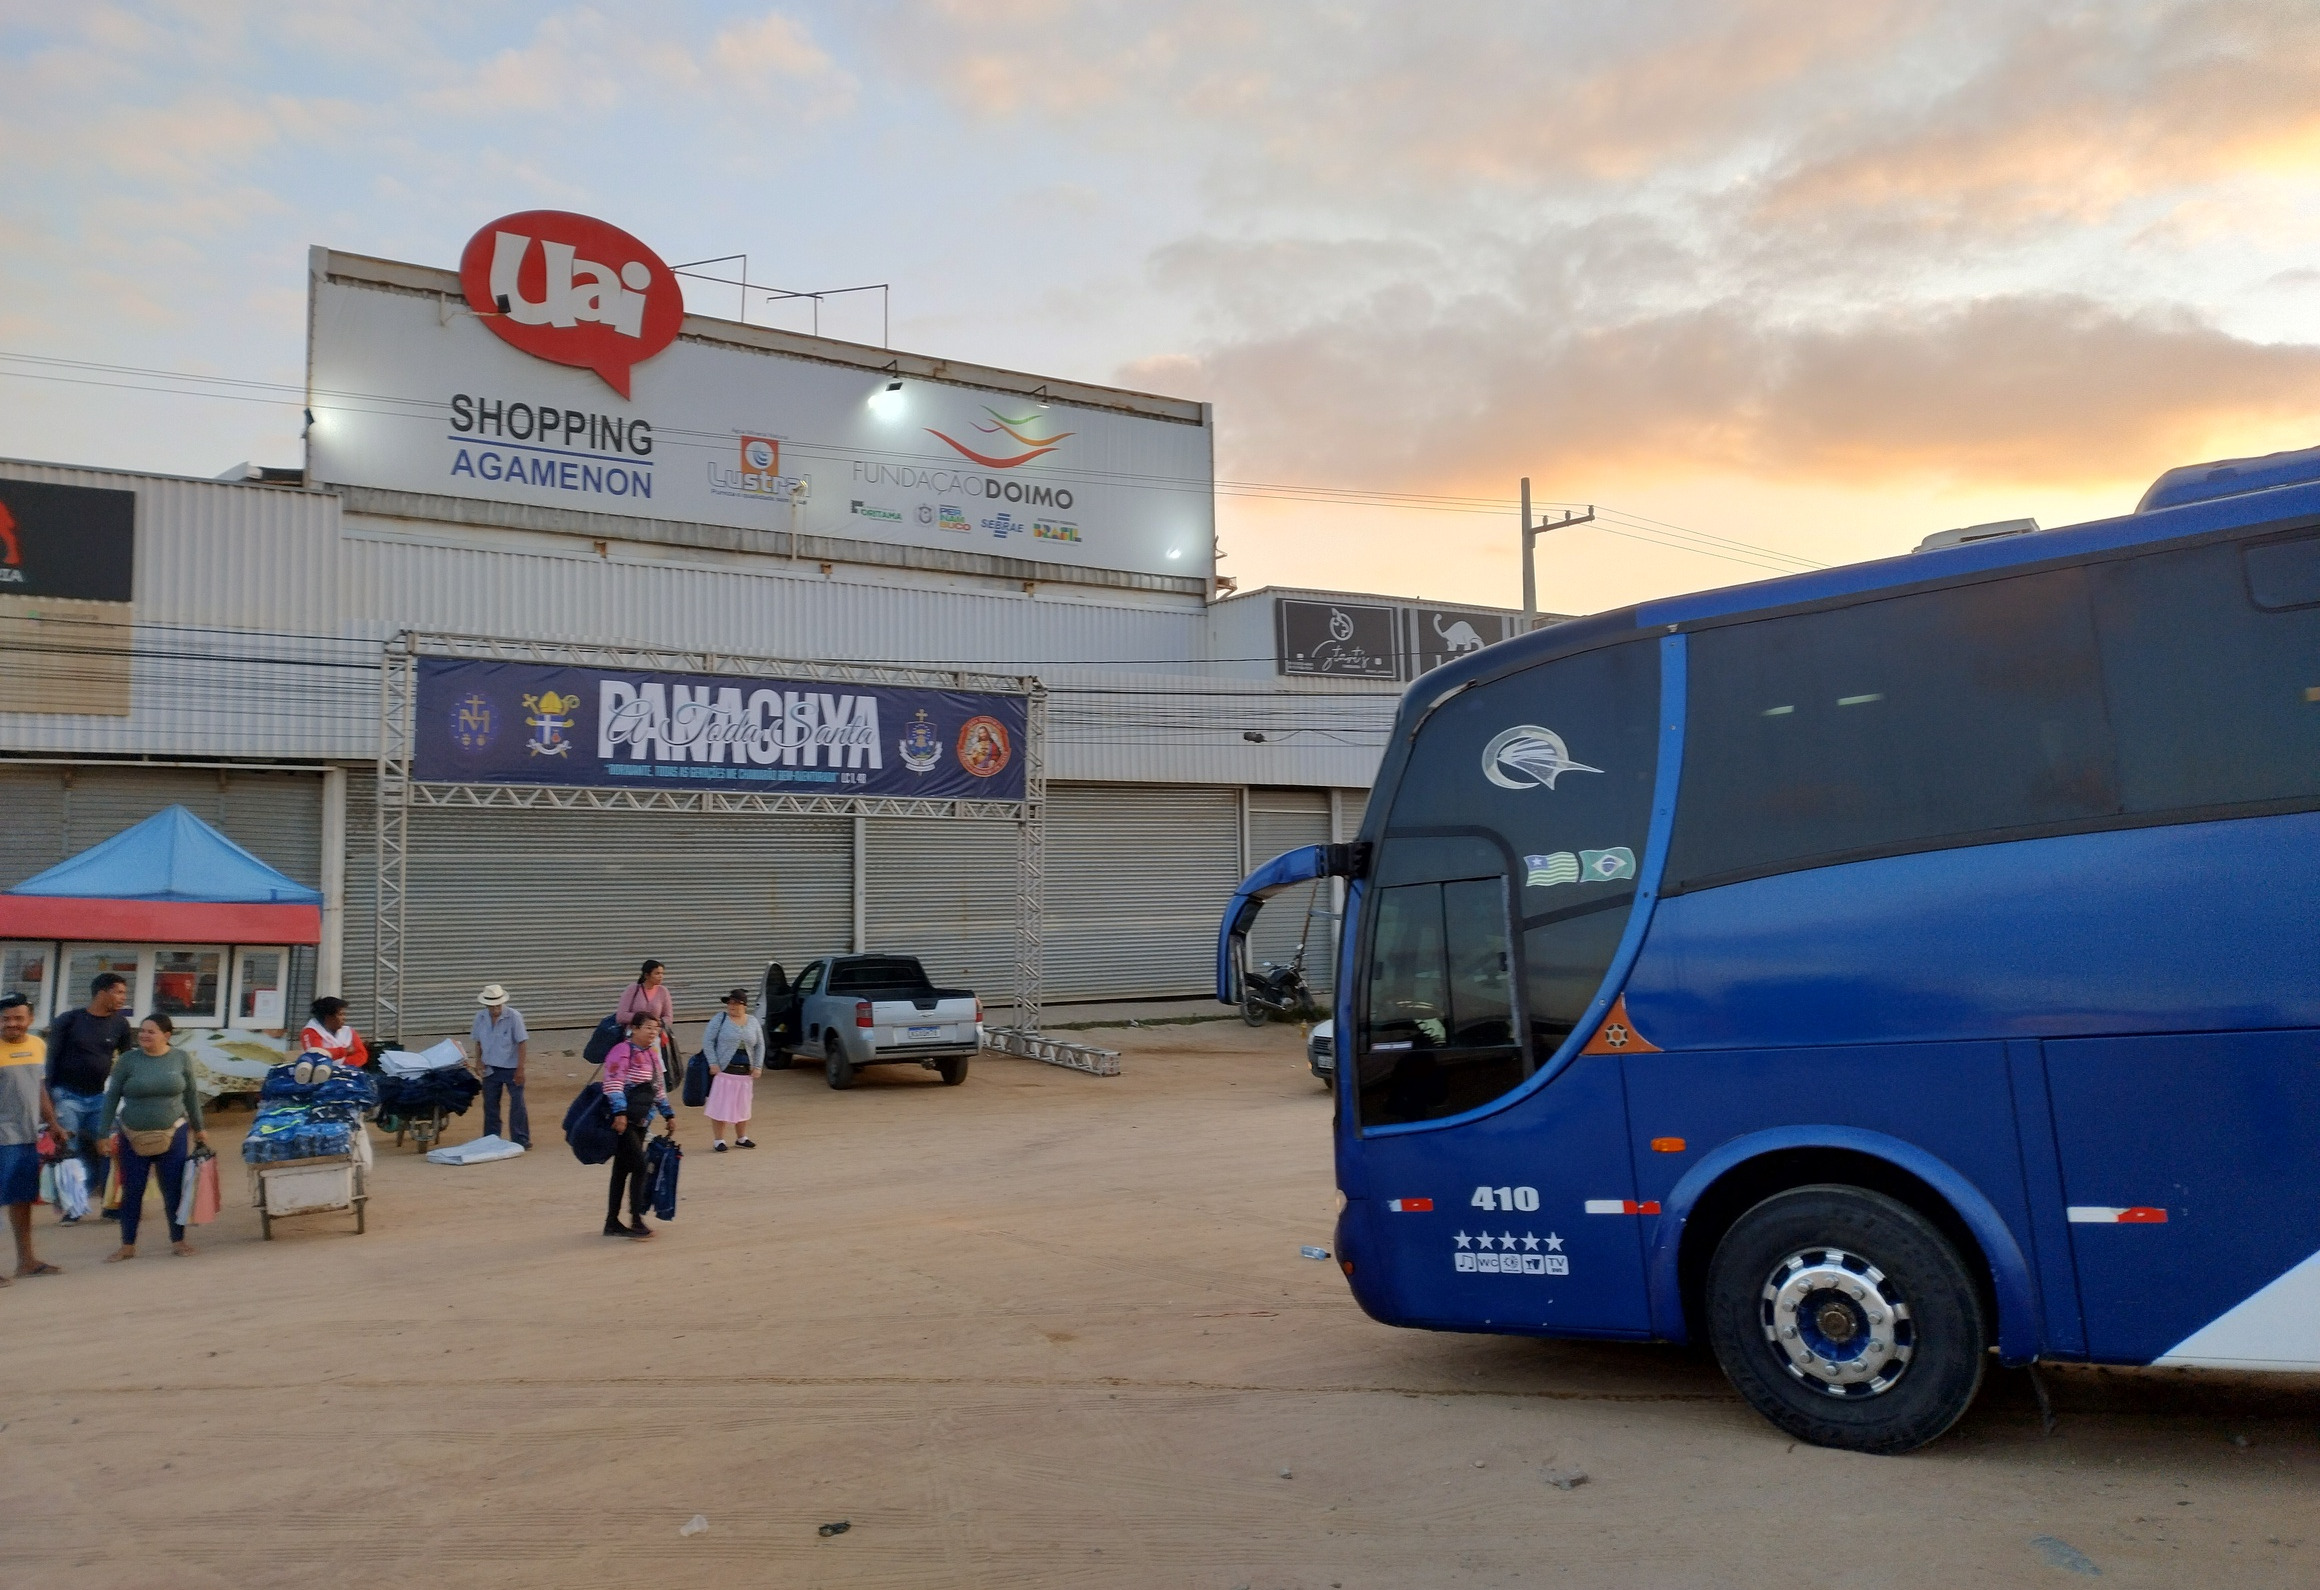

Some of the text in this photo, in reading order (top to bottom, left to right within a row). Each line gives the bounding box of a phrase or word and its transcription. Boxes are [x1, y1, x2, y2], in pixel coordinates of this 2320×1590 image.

[489, 231, 651, 338] Uai
[450, 394, 653, 455] SHOPPING
[450, 449, 652, 498] AGAMENON
[707, 461, 811, 498] Lustral
[980, 518, 1025, 533] SEBRAE
[1033, 522, 1082, 542] BRASIL
[598, 680, 883, 769] PANAGHYA
[770, 701, 876, 748] Santa
[1471, 1186, 1540, 1211] 410
[1478, 1257, 1564, 1267] WC TV
